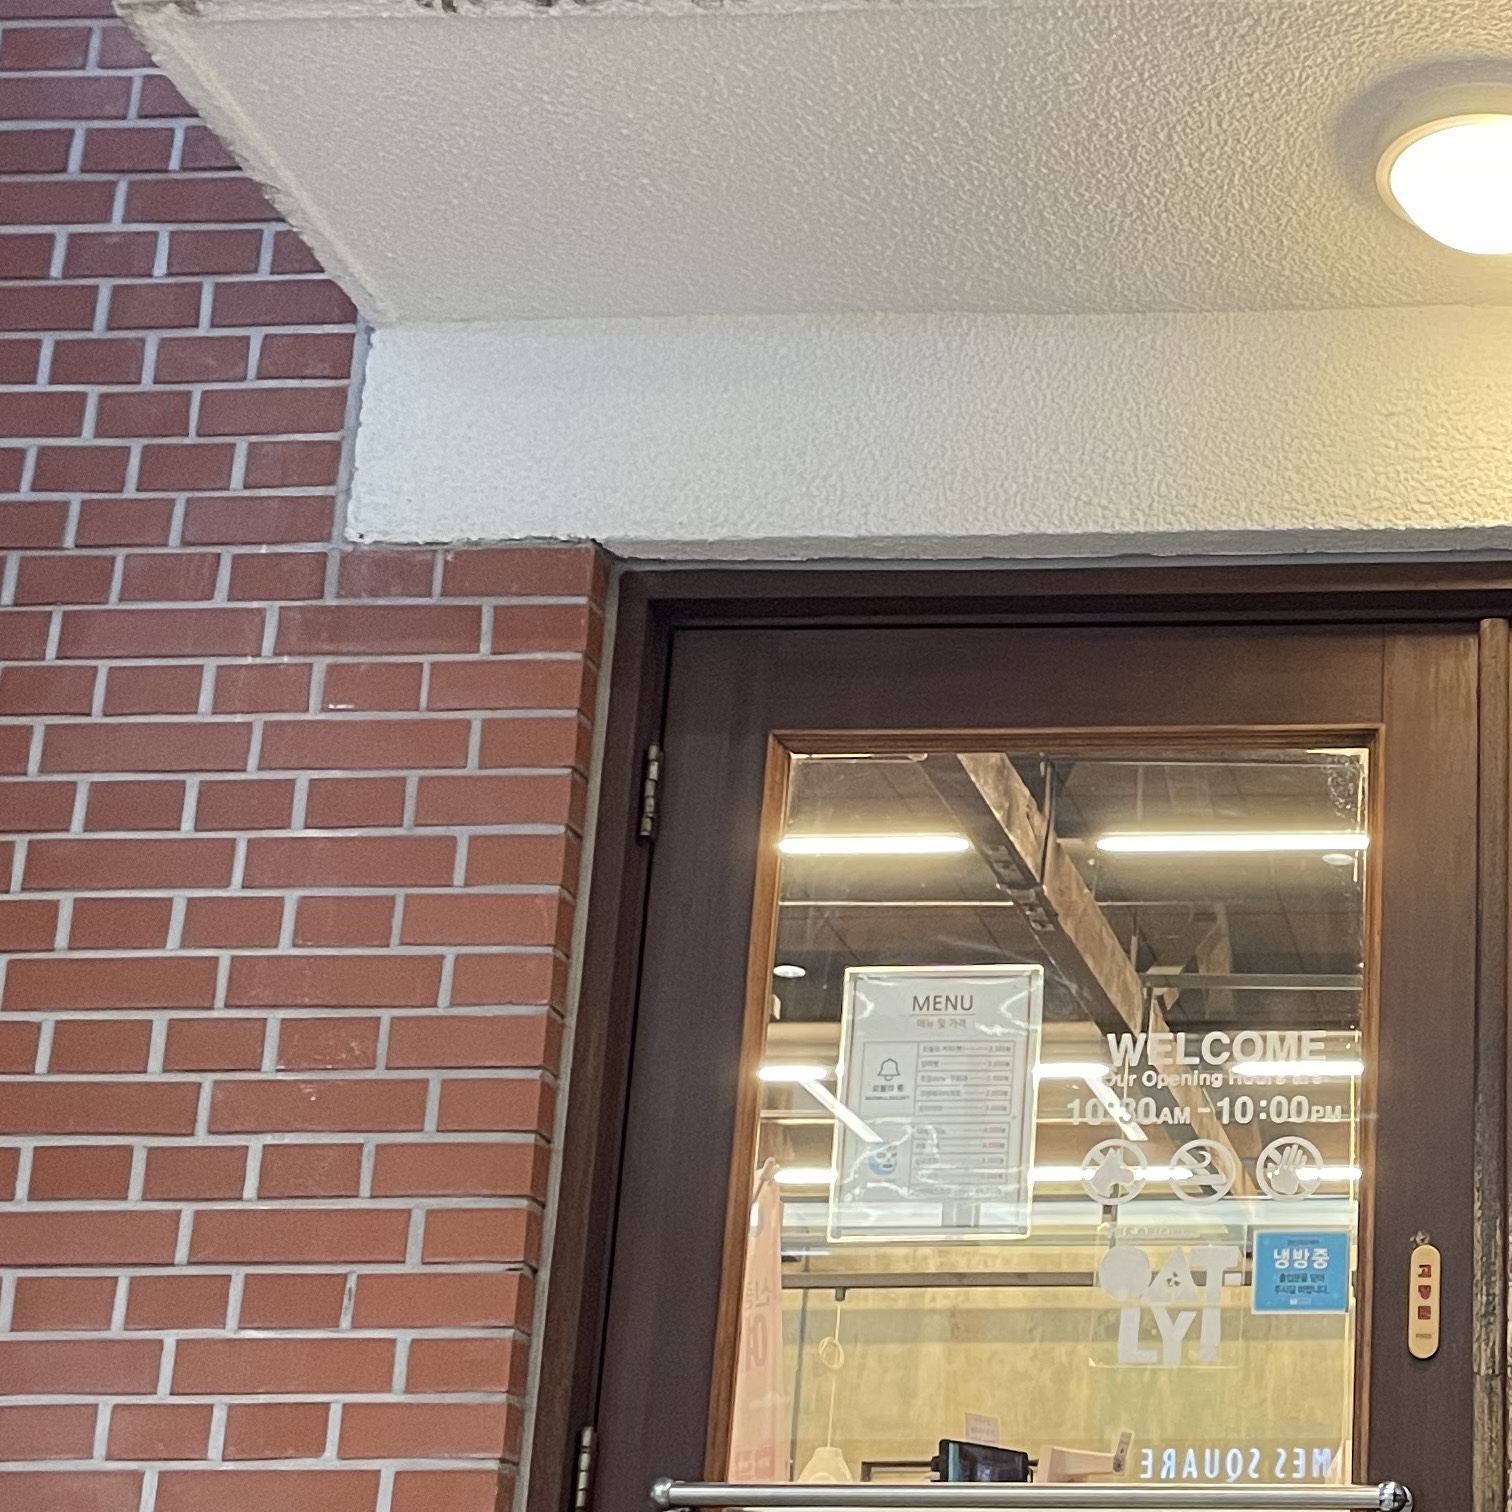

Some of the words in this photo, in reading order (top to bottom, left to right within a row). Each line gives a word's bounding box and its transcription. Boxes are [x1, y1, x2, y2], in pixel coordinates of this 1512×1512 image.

[912, 995, 974, 1012] MENU
[1106, 1030, 1327, 1066] WELCOME
[1104, 1071, 1136, 1087] Our
[1141, 1070, 1223, 1088] Opening
[1216, 1096, 1343, 1125] 10:00PM
[1273, 1247, 1330, 1270] 냉방중
